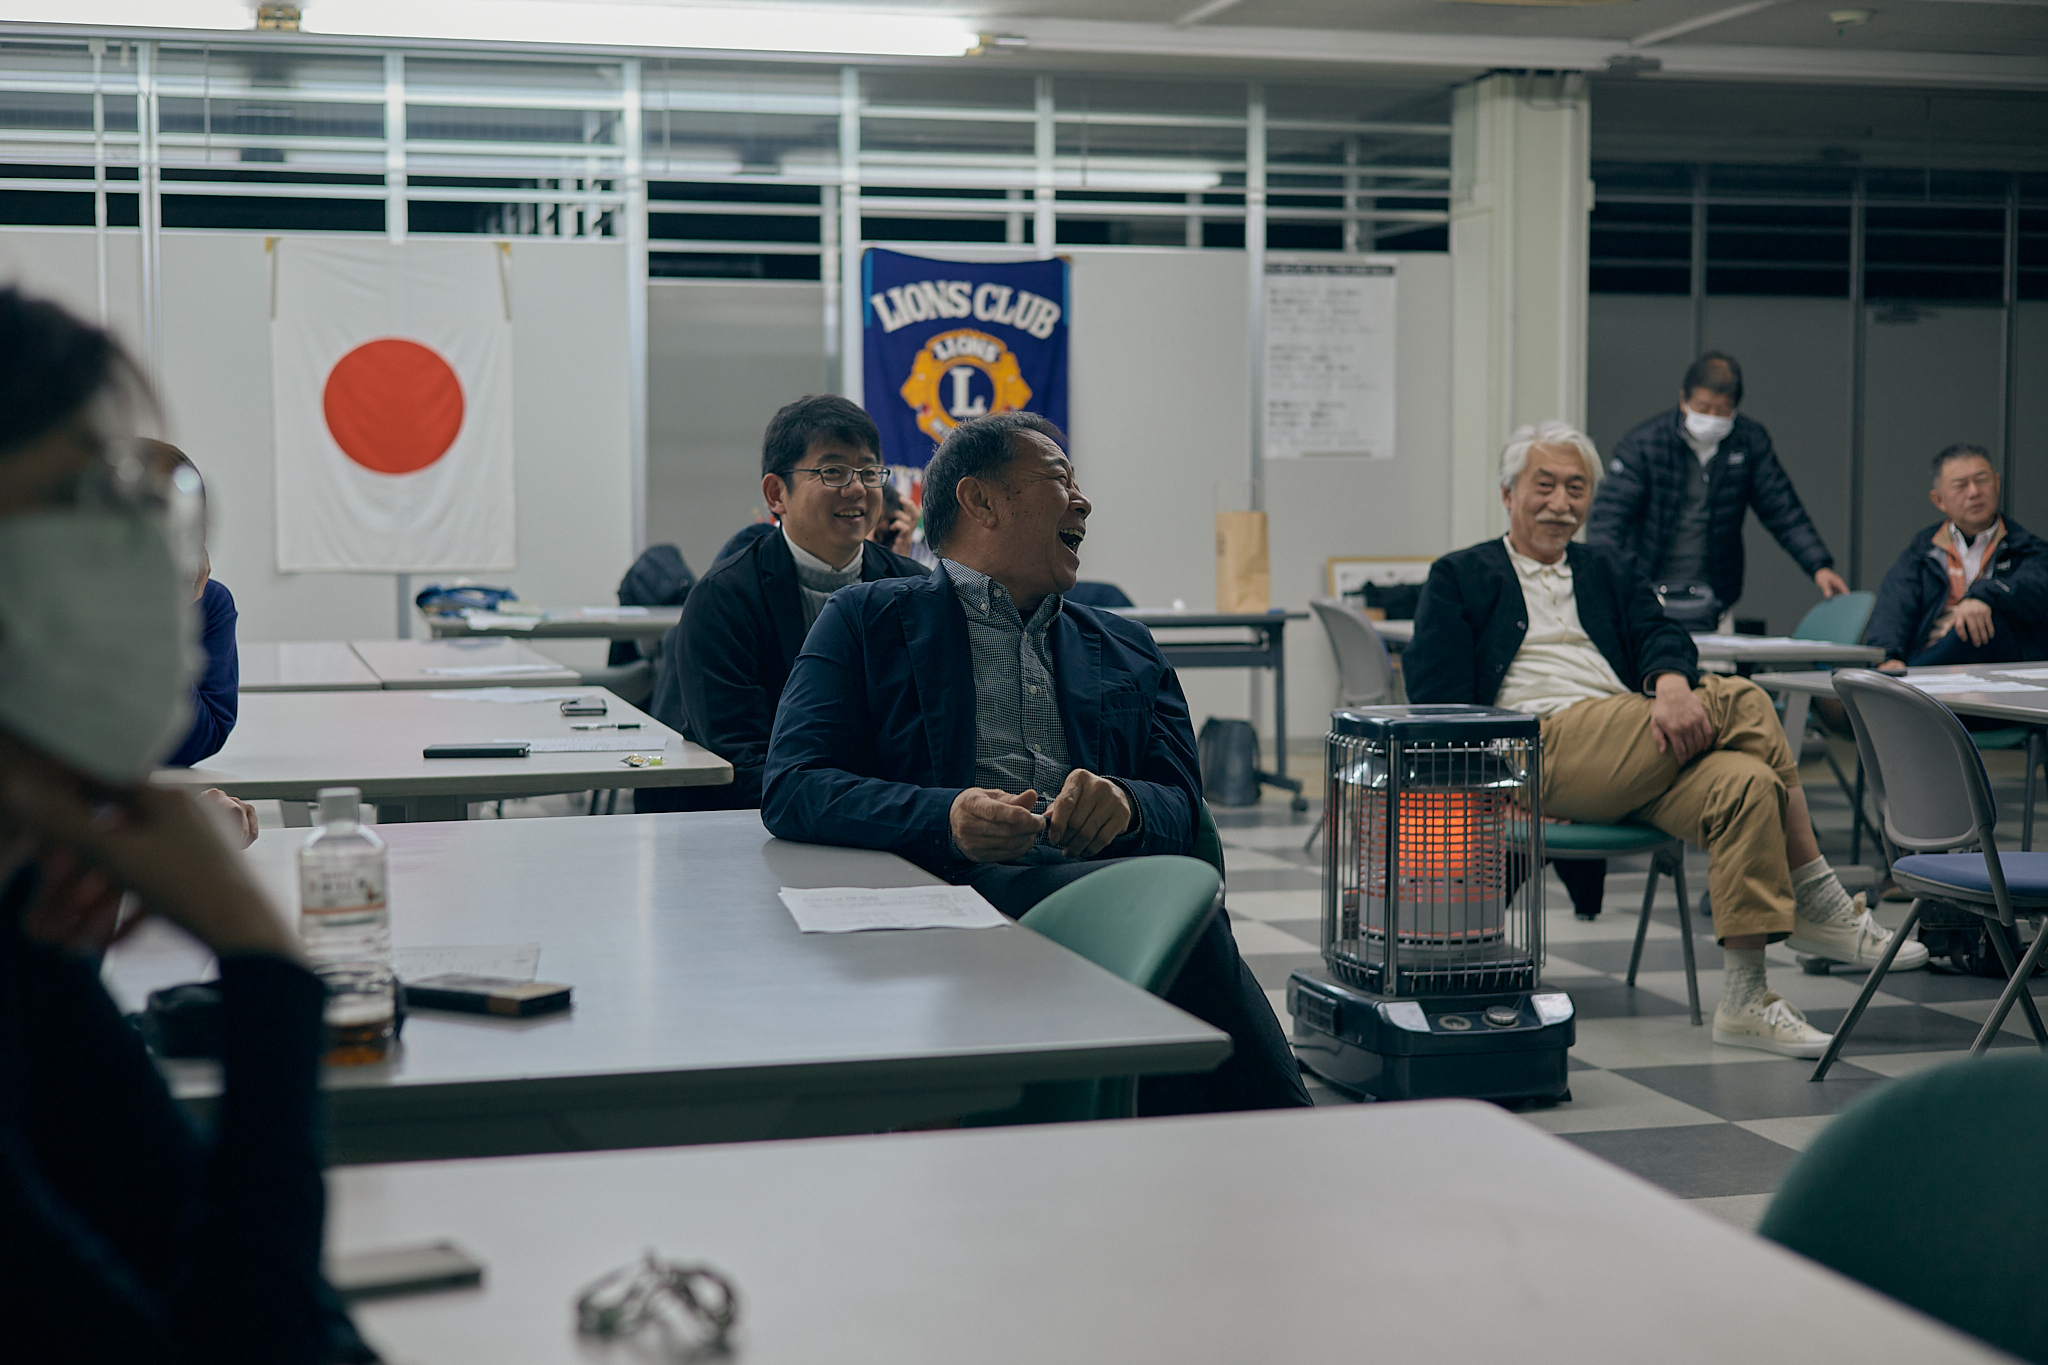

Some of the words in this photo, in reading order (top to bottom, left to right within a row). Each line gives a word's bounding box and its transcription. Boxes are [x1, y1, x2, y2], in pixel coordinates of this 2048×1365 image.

[870, 280, 972, 333] LIONS
[973, 282, 1062, 340] CLUB
[932, 335, 1001, 364] LIONS
[950, 366, 987, 418] L
